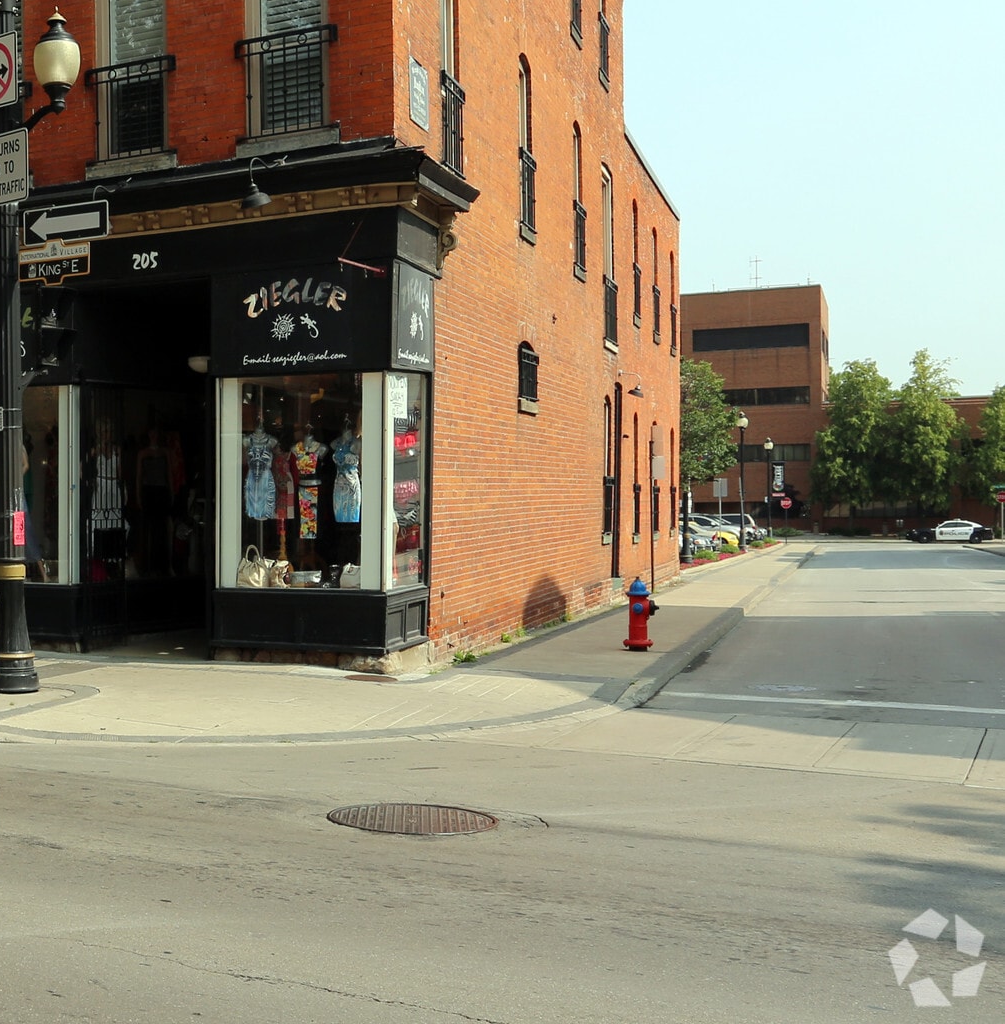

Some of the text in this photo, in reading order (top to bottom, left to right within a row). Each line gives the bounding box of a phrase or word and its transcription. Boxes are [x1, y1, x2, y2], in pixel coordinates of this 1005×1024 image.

[3, 161, 15, 174] TO
[21, 246, 87, 261] INTERNATIONAL VILLAGE
[132, 251, 159, 270] 205
[38, 263, 61, 276] KING
[71, 259, 79, 272] E
[243, 277, 347, 318] ZIEGLER
